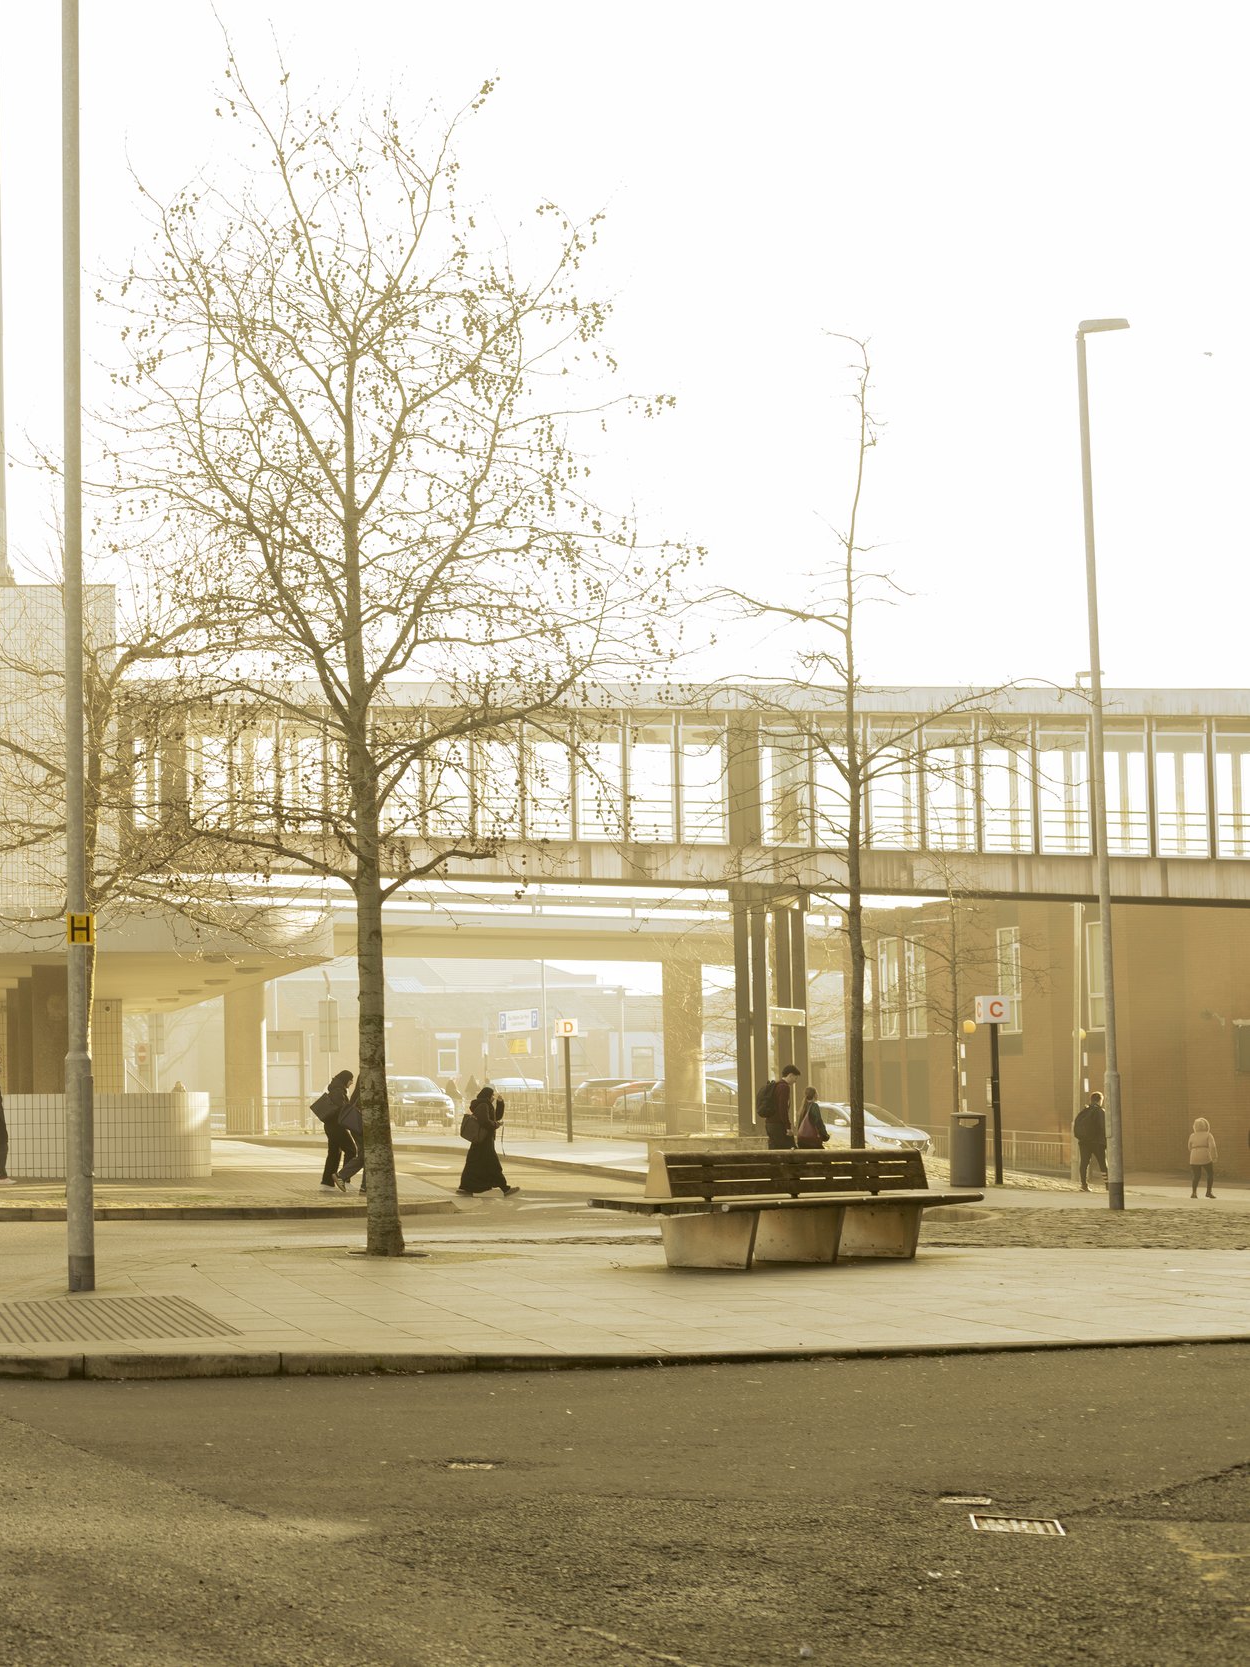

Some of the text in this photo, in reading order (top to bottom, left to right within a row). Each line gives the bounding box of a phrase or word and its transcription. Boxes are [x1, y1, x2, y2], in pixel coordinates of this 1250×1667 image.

[71, 916, 90, 942] H
[977, 1001, 982, 1018] C
[989, 1001, 1004, 1018] C
[564, 1022, 573, 1033] D
